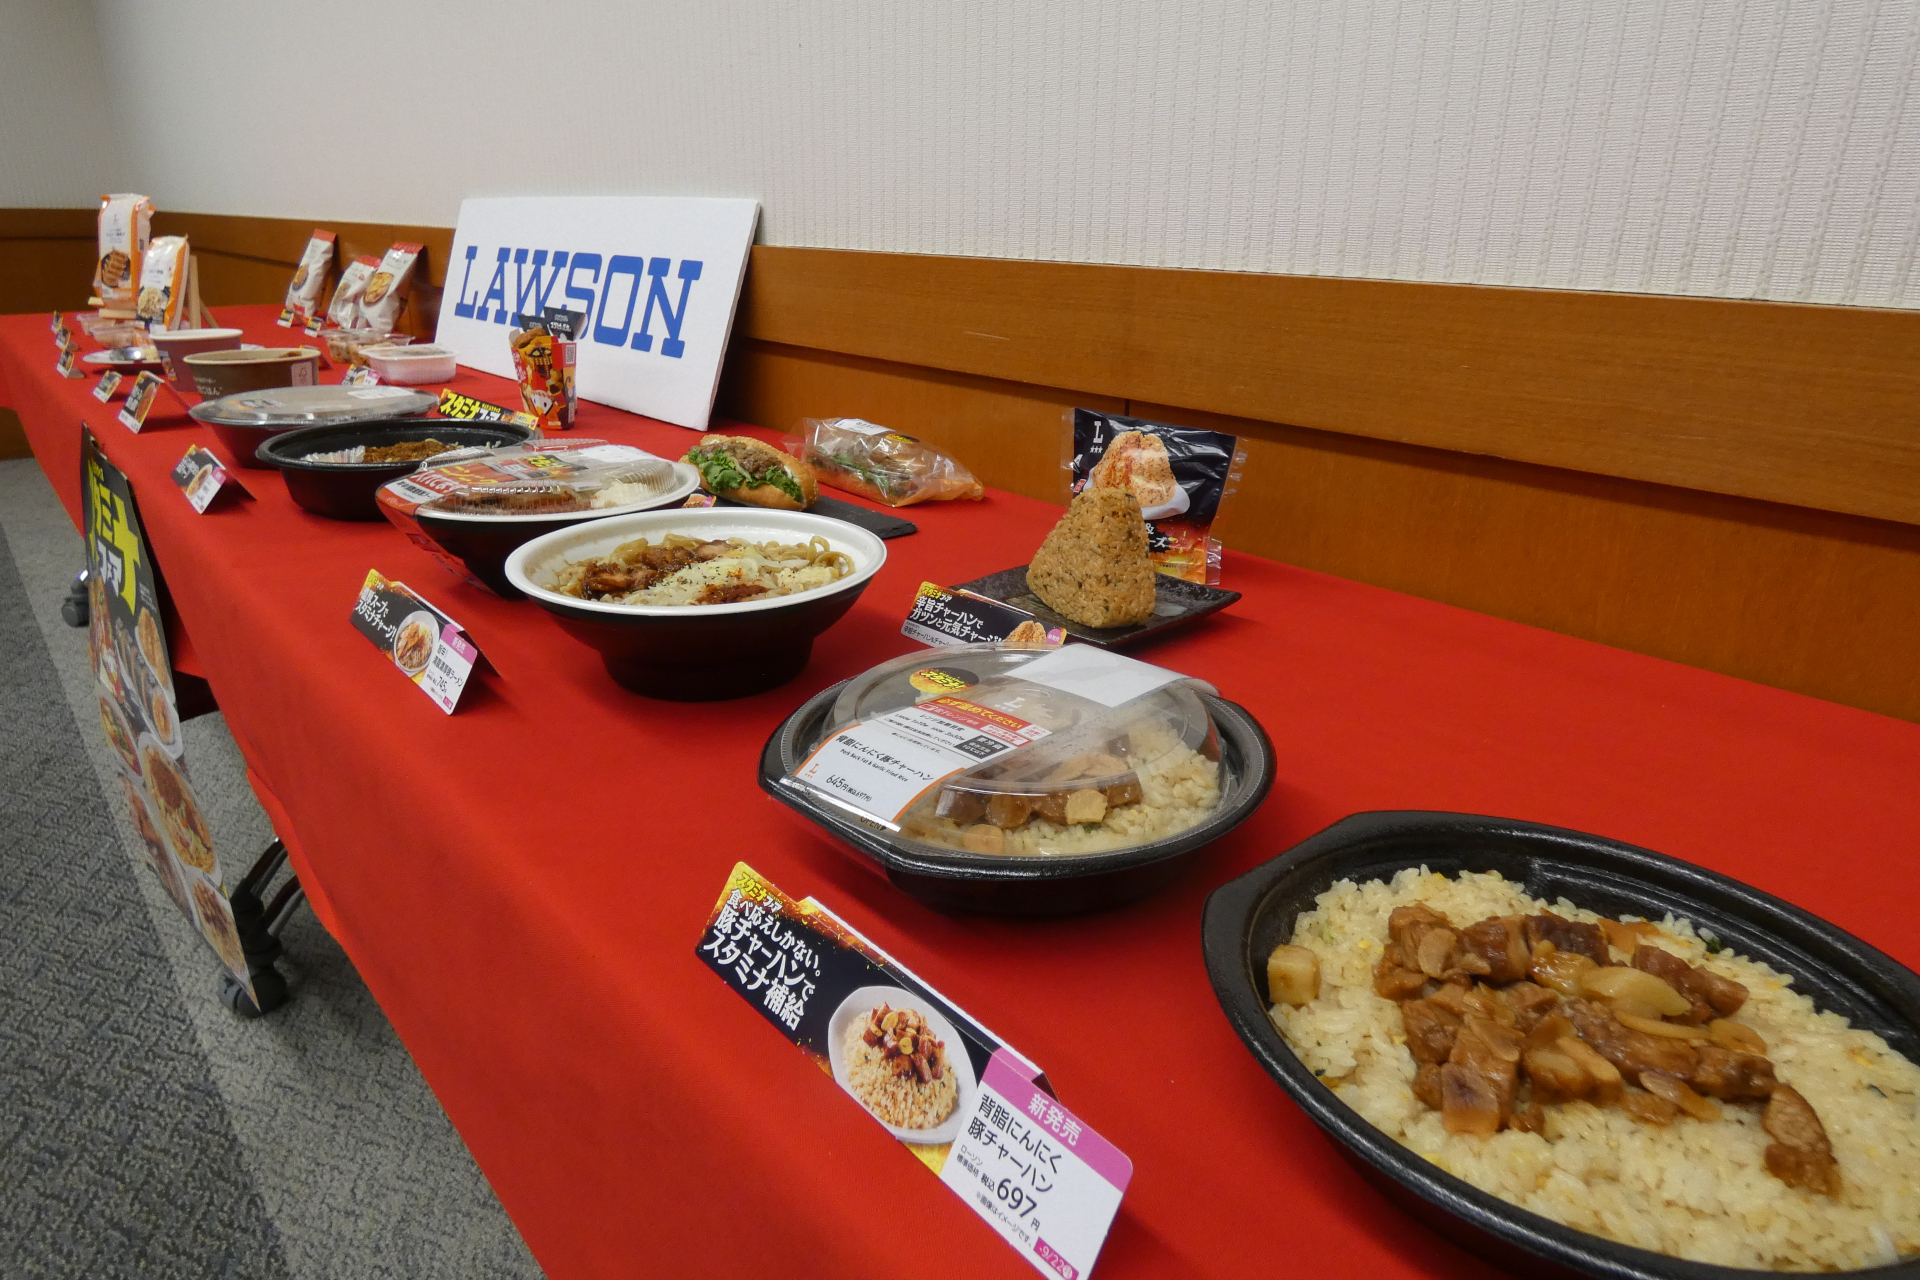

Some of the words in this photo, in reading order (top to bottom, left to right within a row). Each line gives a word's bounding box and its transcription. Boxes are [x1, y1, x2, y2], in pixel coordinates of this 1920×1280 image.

[454, 246, 703, 359] LAWSON
[915, 595, 984, 630] 辛旨チャーハンで
[736, 871, 783, 913] スタミナフェア
[714, 903, 816, 1002] 豚チャーハンで
[726, 888, 821, 977] 食べ応えしかない。
[703, 929, 804, 1031] スタミナ補給
[961, 1145, 983, 1166] ローソン
[967, 1116, 1053, 1193] 豚チャーハン
[978, 1093, 1062, 1174] 背脂にんにく
[1027, 1093, 1082, 1146] 新発売
